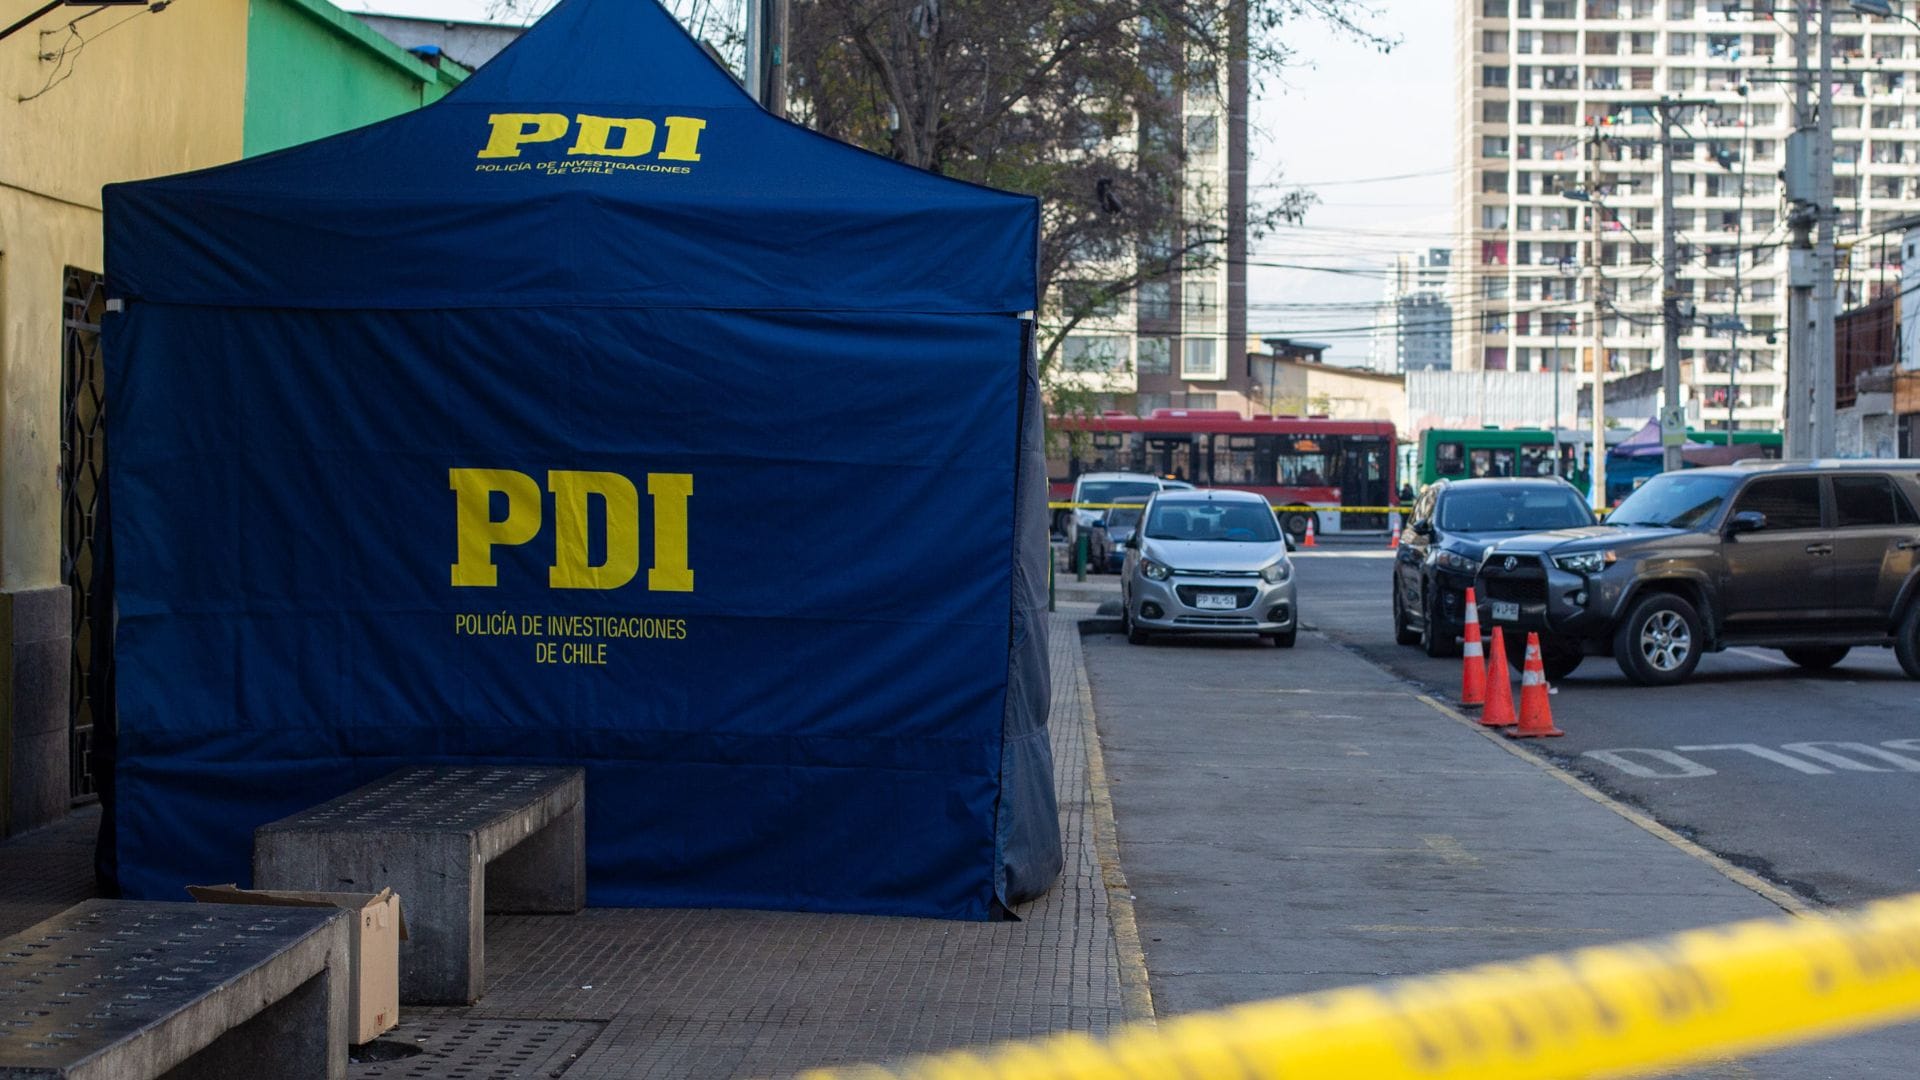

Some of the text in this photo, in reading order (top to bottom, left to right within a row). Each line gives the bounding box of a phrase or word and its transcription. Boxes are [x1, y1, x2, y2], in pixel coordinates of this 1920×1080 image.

[476, 113, 706, 162] PDI
[475, 160, 691, 175] POLICÍA DE INVESTIGACIONES
[546, 166, 614, 175] DE CHILE
[449, 468, 694, 592] PDI
[455, 610, 687, 639] POLICÍA DE INVESTIGACIONES
[536, 642, 607, 664] DE CHILE
